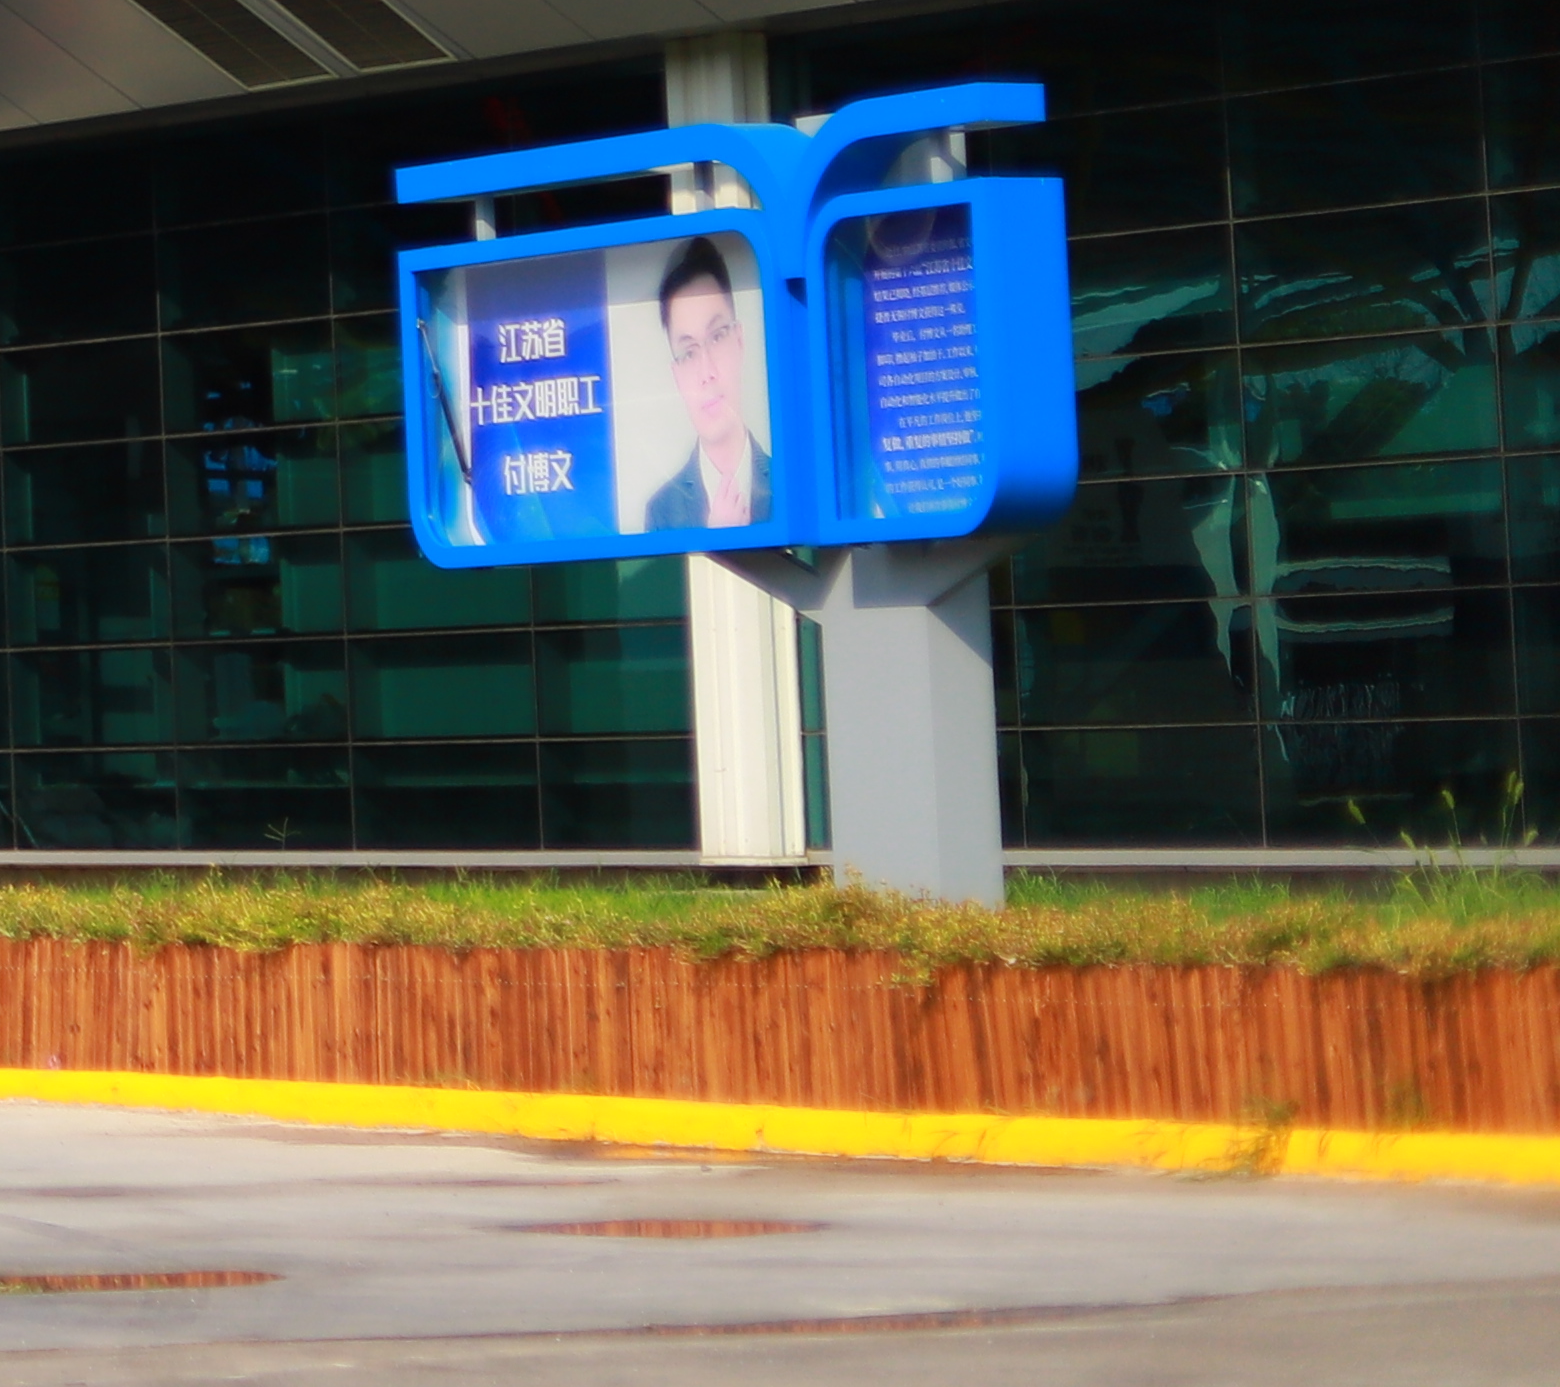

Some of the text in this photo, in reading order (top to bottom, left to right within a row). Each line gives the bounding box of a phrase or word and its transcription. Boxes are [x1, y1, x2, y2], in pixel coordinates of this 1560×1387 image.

[498, 318, 566, 364] 江苏省
[470, 375, 603, 426] 十佳文明职工
[503, 449, 575, 496] 付博文
